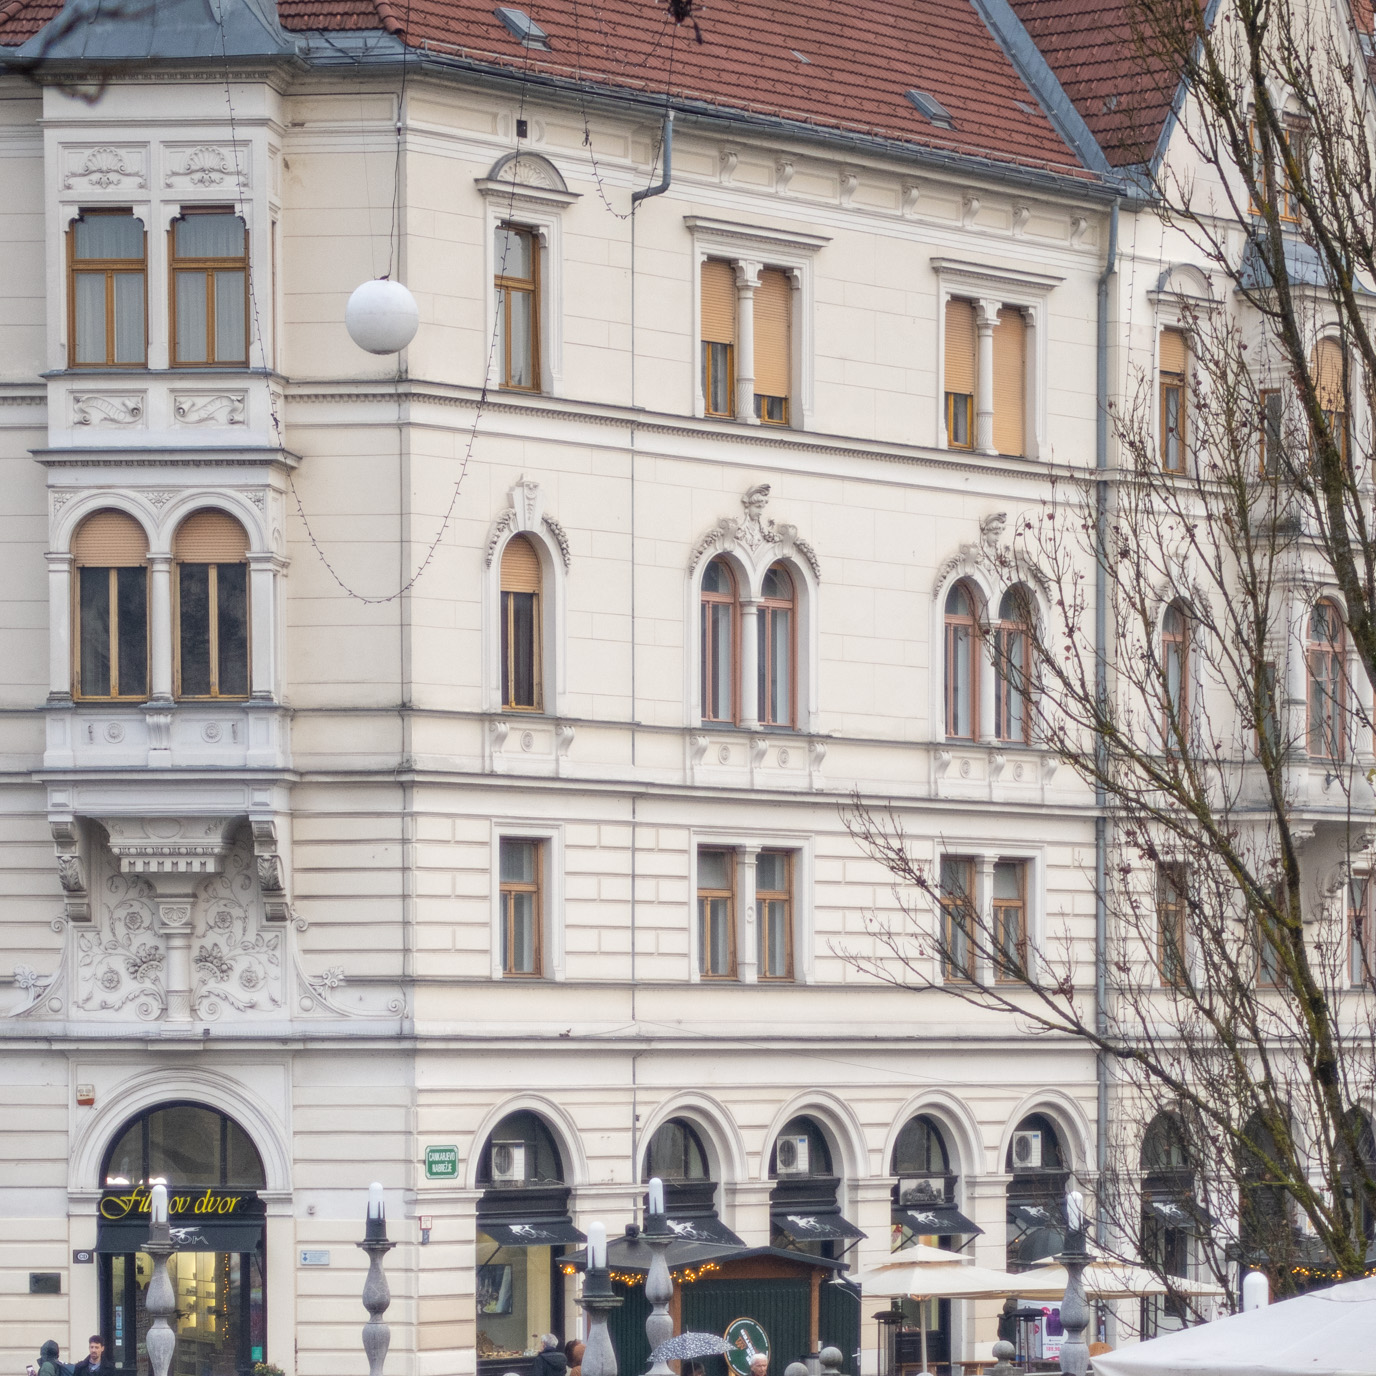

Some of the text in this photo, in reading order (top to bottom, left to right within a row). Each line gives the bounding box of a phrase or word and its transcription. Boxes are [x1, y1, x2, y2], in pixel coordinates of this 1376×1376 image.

[429, 1152, 455, 1161] CANKARJEVO
[100, 1186, 241, 1219] Filov dvor
